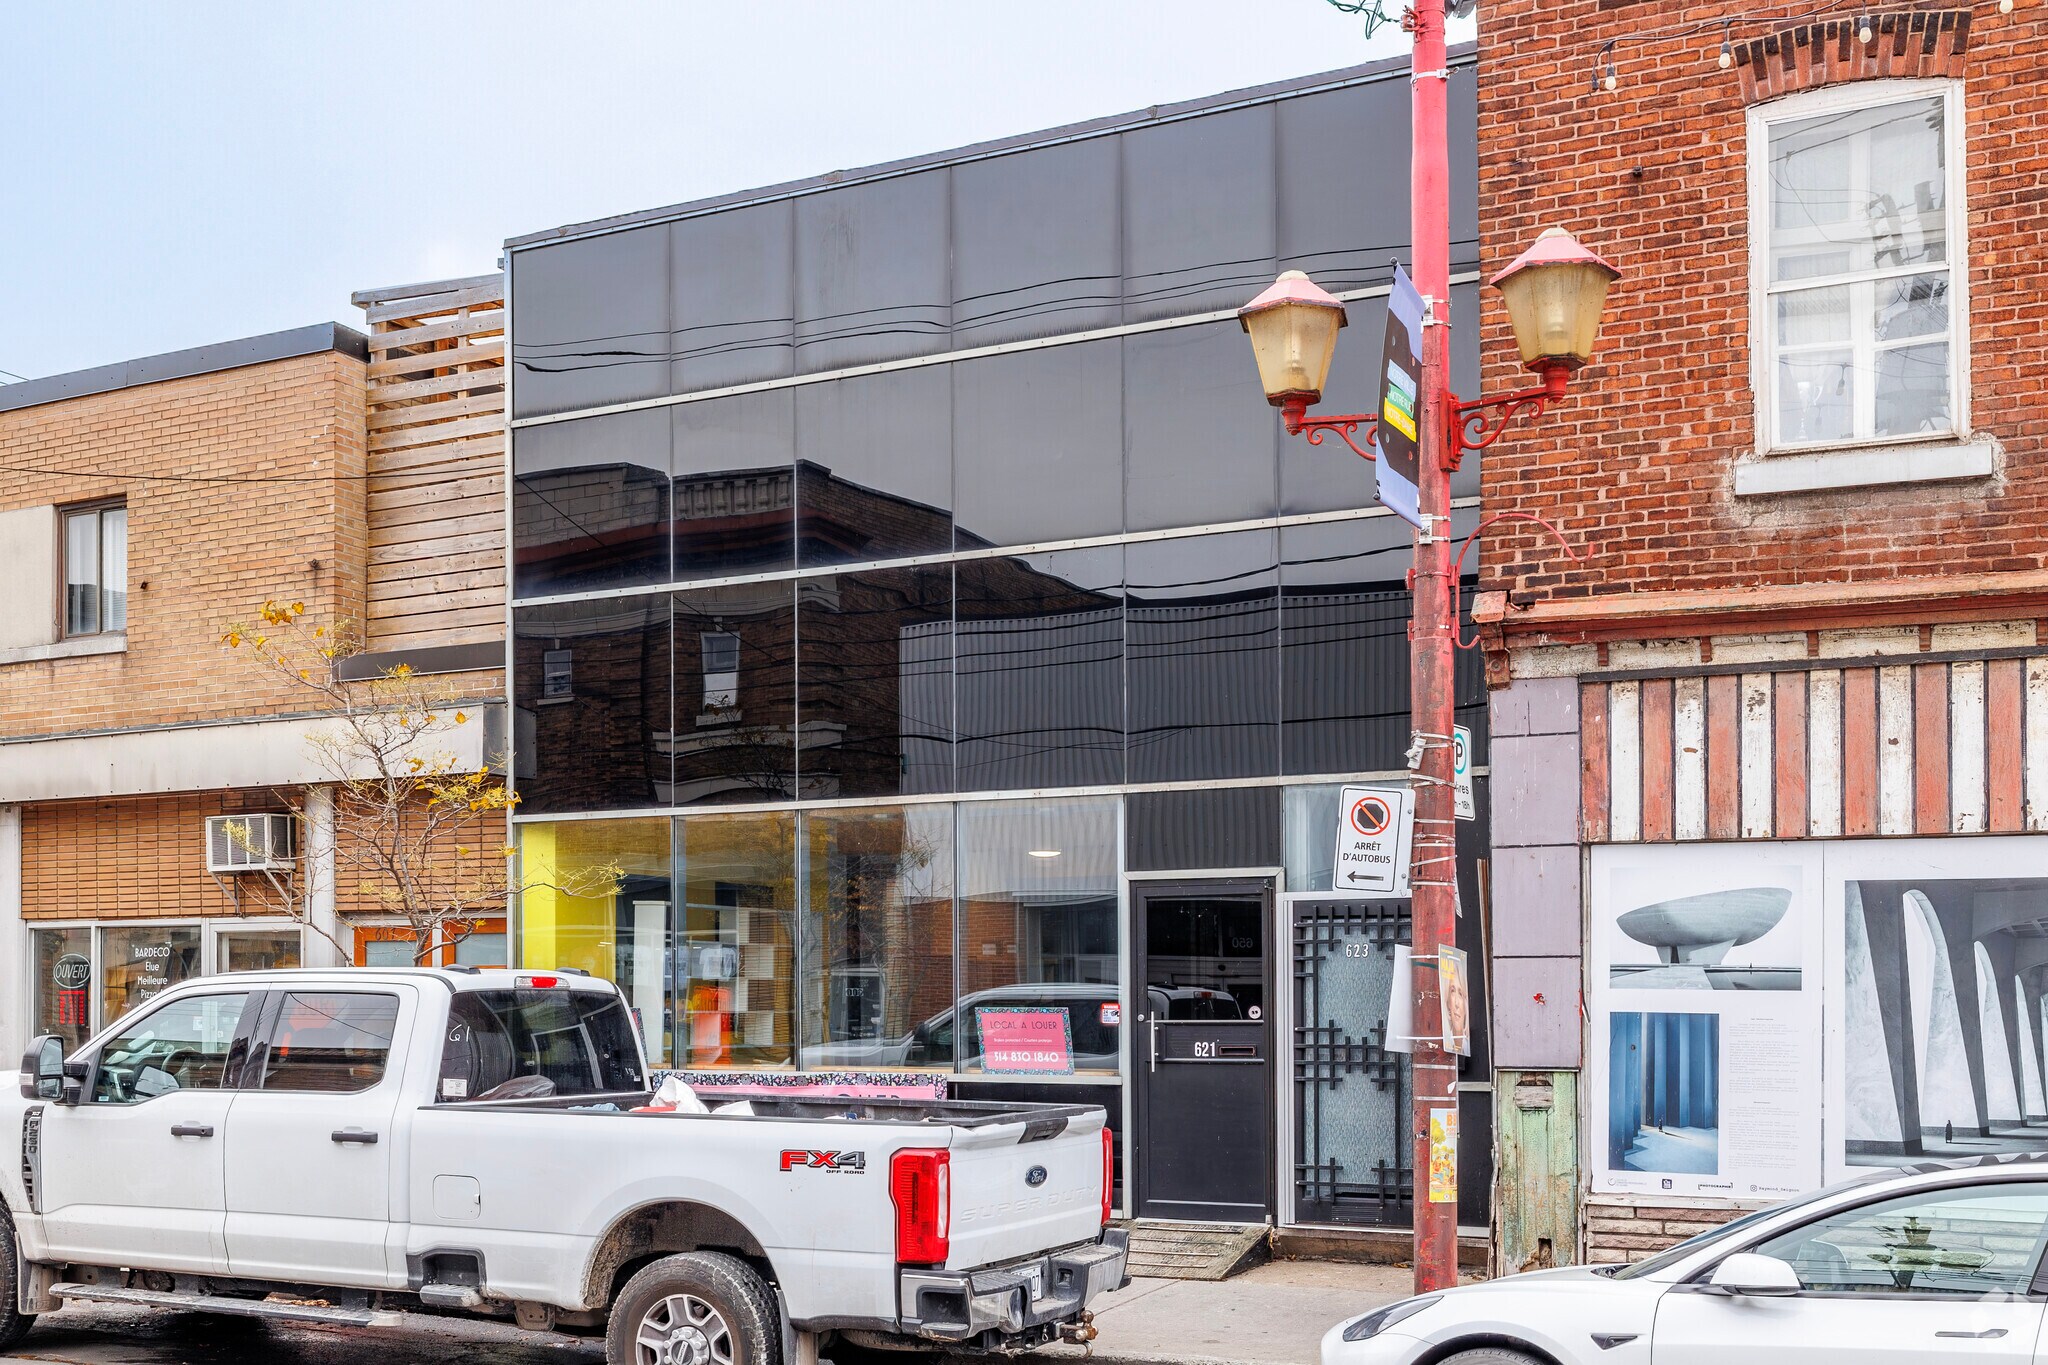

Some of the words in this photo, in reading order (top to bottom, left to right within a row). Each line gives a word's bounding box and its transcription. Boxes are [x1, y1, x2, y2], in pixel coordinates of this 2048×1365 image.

[1455, 741, 1464, 766] P
[1354, 840, 1382, 851] ARRÊT
[1342, 852, 1391, 864] D'AUTOBUS
[135, 946, 171, 958] BARDECO
[1345, 943, 1369, 958] 623
[55, 964, 89, 979] OUVERT
[137, 975, 168, 986] Meilleure
[990, 1020, 1016, 1030] LOCAL
[1031, 1020, 1058, 1030] LOUER
[1194, 1041, 1216, 1057] 621
[994, 1051, 1008, 1063] 514
[1010, 1051, 1031, 1063] 830
[1033, 1051, 1059, 1063] 1840
[779, 1148, 867, 1172] FX4
[960, 1196, 1042, 1224] SUPER
[1049, 1185, 1097, 1206] DUTY
